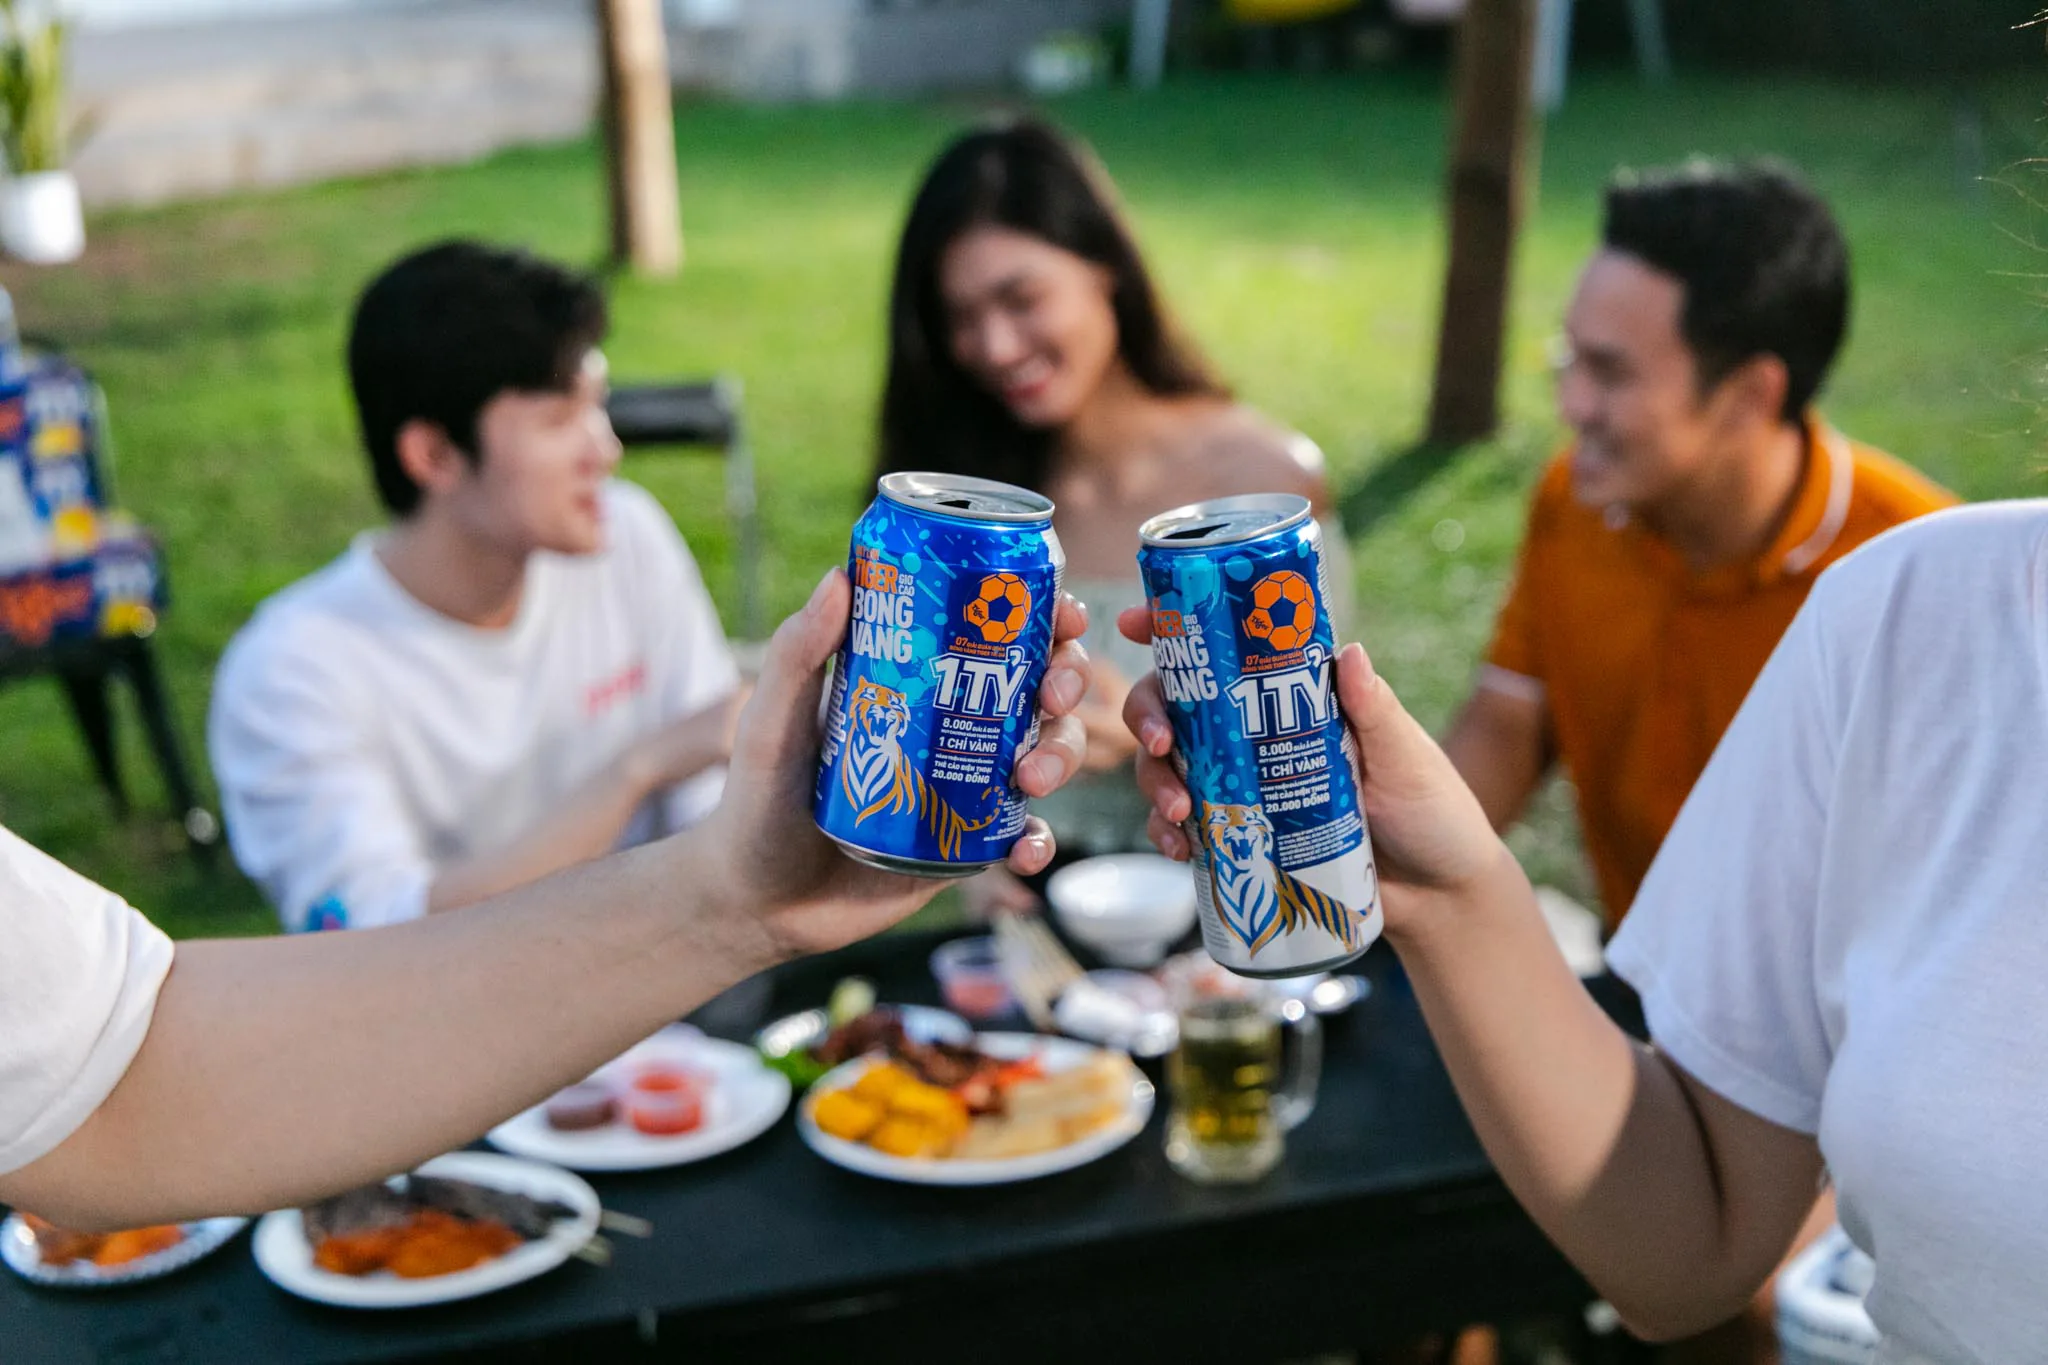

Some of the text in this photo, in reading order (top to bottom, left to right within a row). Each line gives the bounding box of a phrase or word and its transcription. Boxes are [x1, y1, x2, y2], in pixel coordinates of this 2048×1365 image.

[856, 558, 898, 594] TIGER
[853, 586, 914, 629] BONG
[852, 620, 913, 663] VANG
[955, 636, 968, 646] 07
[1152, 635, 1210, 669] BONG
[1245, 654, 1259, 666] 07
[942, 717, 973, 731] 8.000
[939, 736, 945, 747] 1
[969, 739, 997, 753] VÀNG
[1259, 741, 1293, 757] 8.000
[1261, 766, 1268, 778] 1
[1295, 755, 1327, 773] VÀNG
[932, 769, 963, 782] 20.000
[1265, 799, 1301, 813] 20.000
